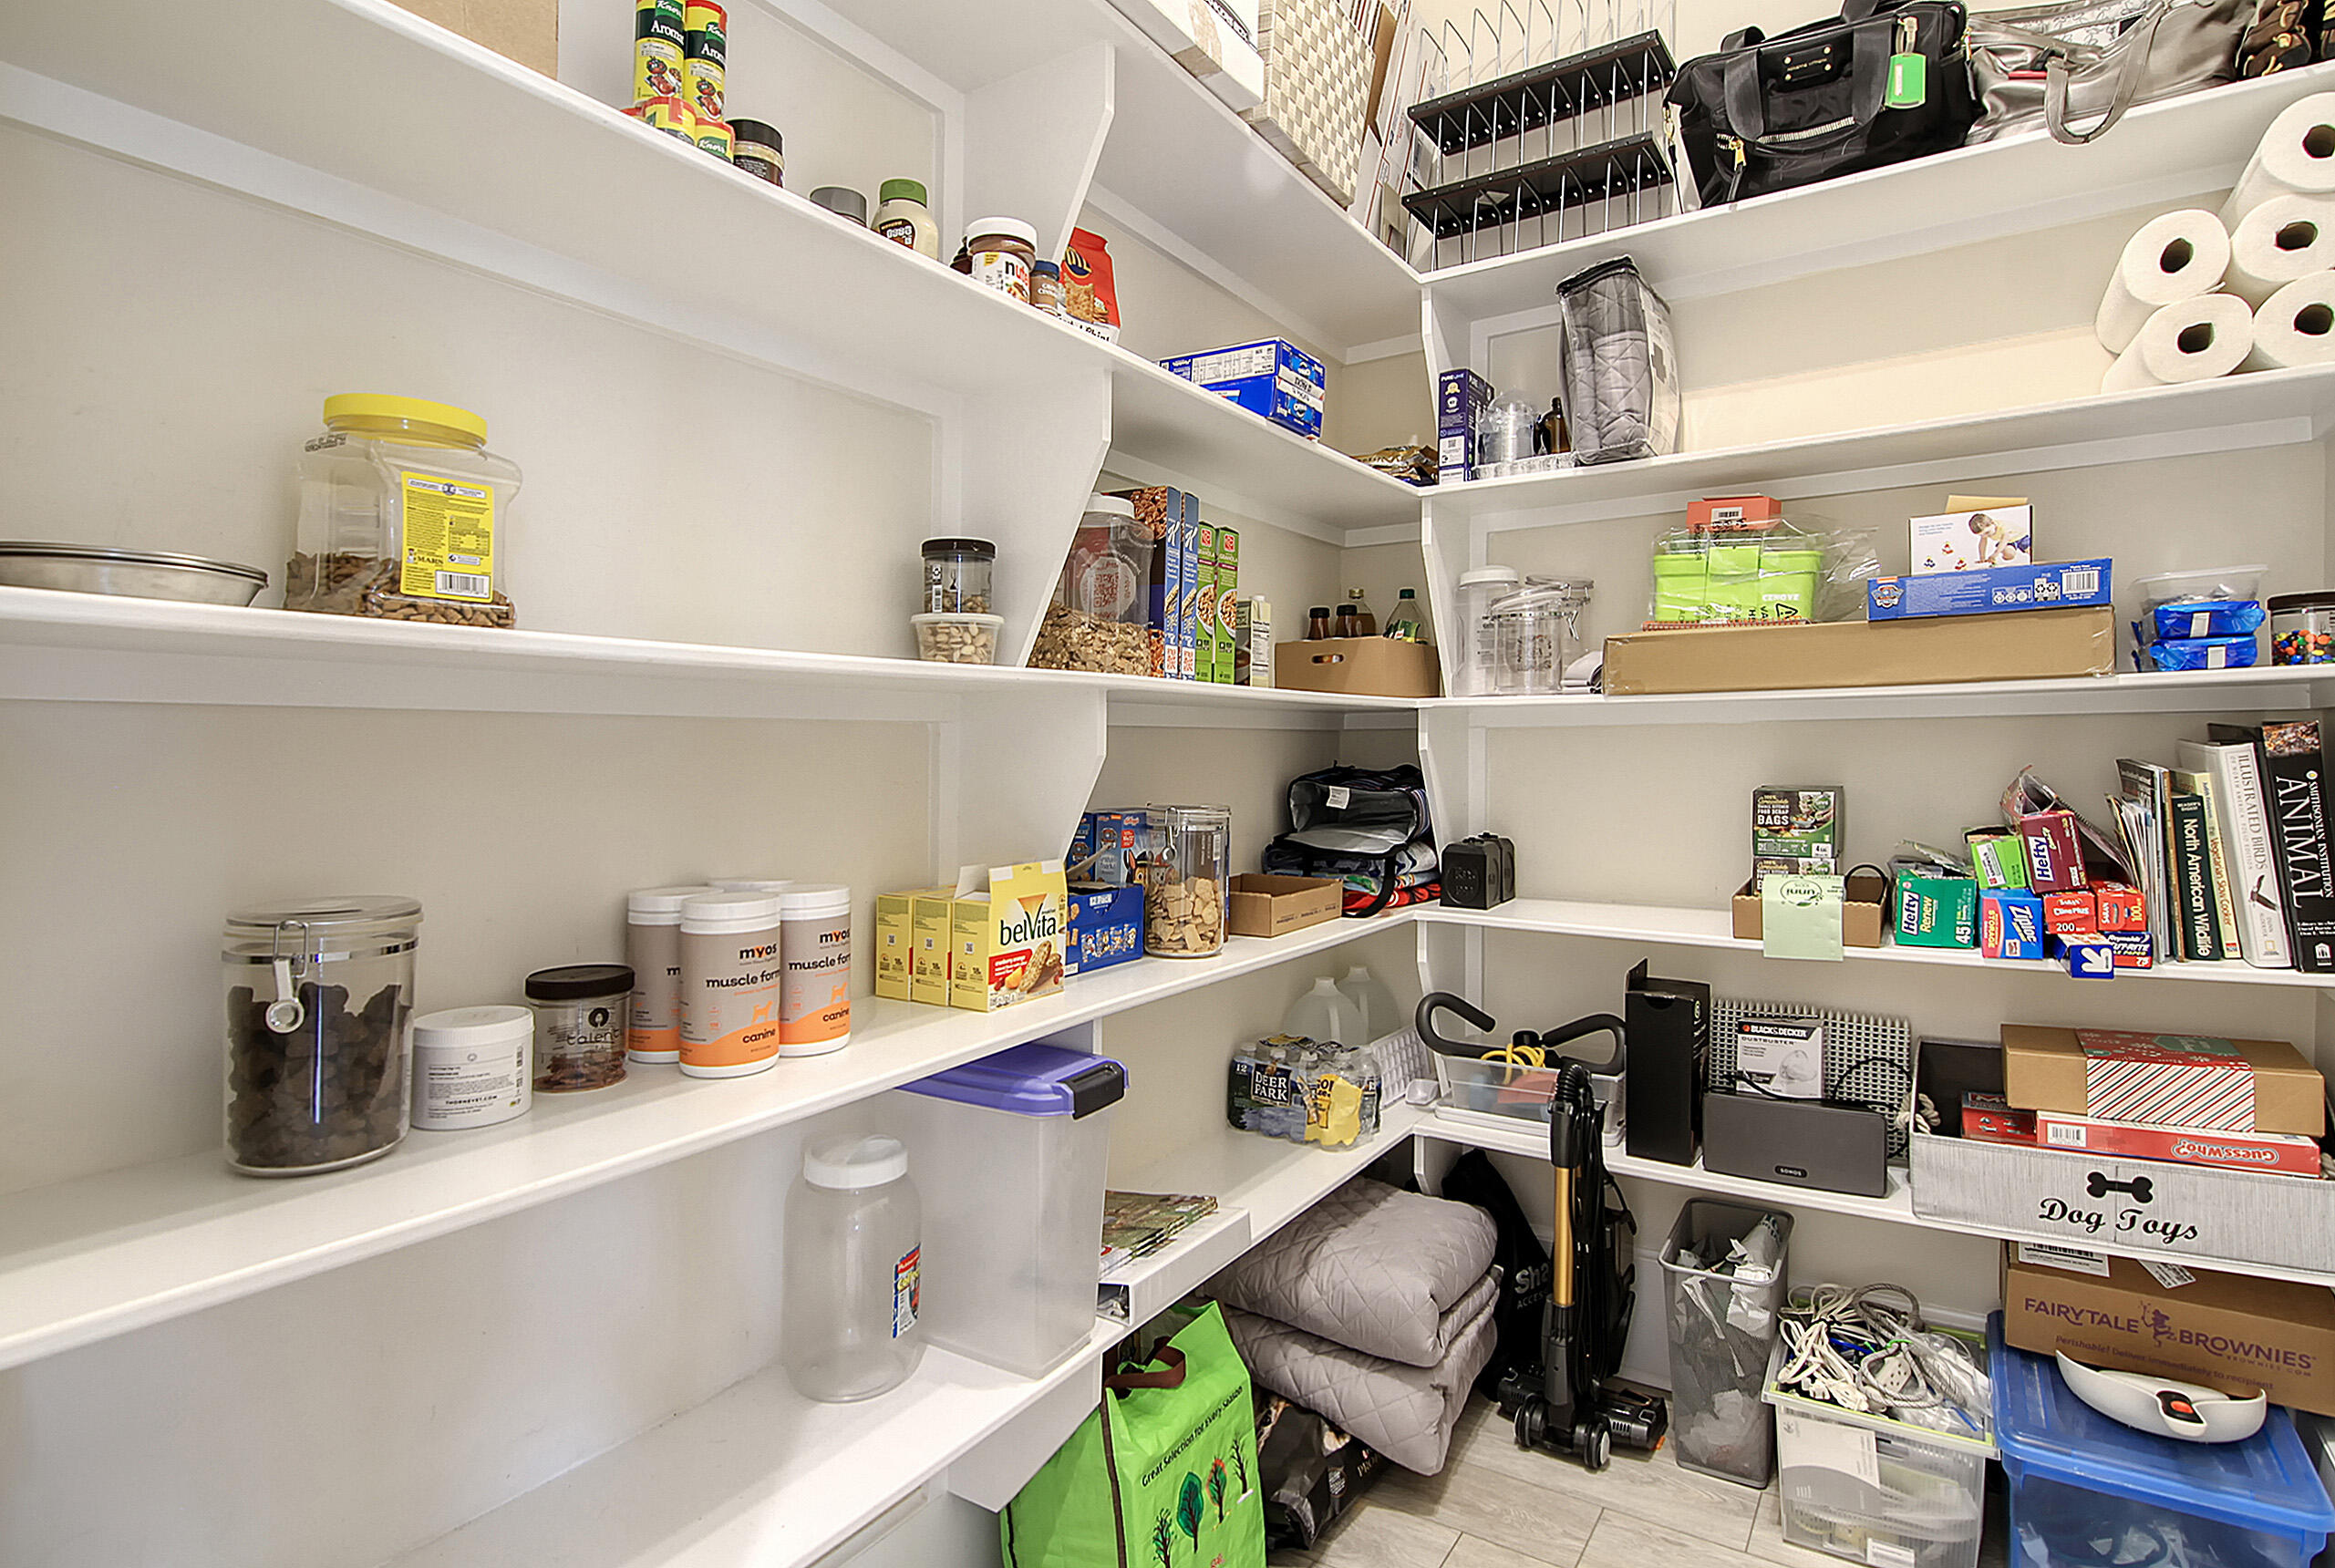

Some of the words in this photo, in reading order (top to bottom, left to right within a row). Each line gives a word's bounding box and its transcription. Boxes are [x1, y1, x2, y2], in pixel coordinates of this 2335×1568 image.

[1757, 814, 1790, 825] BAGS
[2238, 755, 2261, 833] ILLUSTRATED
[2251, 837, 2268, 870] BIRDS
[2309, 781, 2326, 840] SMITHSONIAN
[2183, 819, 2201, 851] North
[2276, 776, 2323, 909] ANIMAL
[2033, 839, 2051, 878] Hefty
[2186, 853, 2206, 912] American
[1000, 903, 1056, 946] belVita
[1904, 894, 1919, 932] Hefty
[1919, 895, 1933, 933] Renew
[2009, 905, 2038, 943] Ziploc
[2056, 923, 2075, 932] 200
[2131, 905, 2143, 922] 100
[739, 943, 777, 960] myos
[820, 928, 851, 944] myos
[1955, 926, 1971, 944] 45
[2194, 913, 2213, 956] Wildlife
[789, 954, 835, 971] muscle
[706, 972, 759, 989] muscle
[742, 1027, 776, 1044] canine
[1235, 1063, 1248, 1073] 12
[1255, 1071, 1287, 1088] DEER
[1255, 1084, 1287, 1101] PARK
[1780, 1167, 1803, 1176] SONOS
[2039, 1197, 2105, 1233] Dog
[2116, 1208, 2199, 1244] Toys
[2025, 1297, 2139, 1334] FAIRYTALE
[2179, 1328, 2312, 1369] BROWNIES
[2056, 1336, 2110, 1354] Perishable!
[2112, 1347, 2145, 1361] Deliver
[2148, 1352, 2212, 1377] immediately
[2213, 1369, 2225, 1379] to
[2226, 1372, 2274, 1389] recipient
[1142, 1463, 1163, 1487] Great
[1163, 1434, 1194, 1466] Selection
